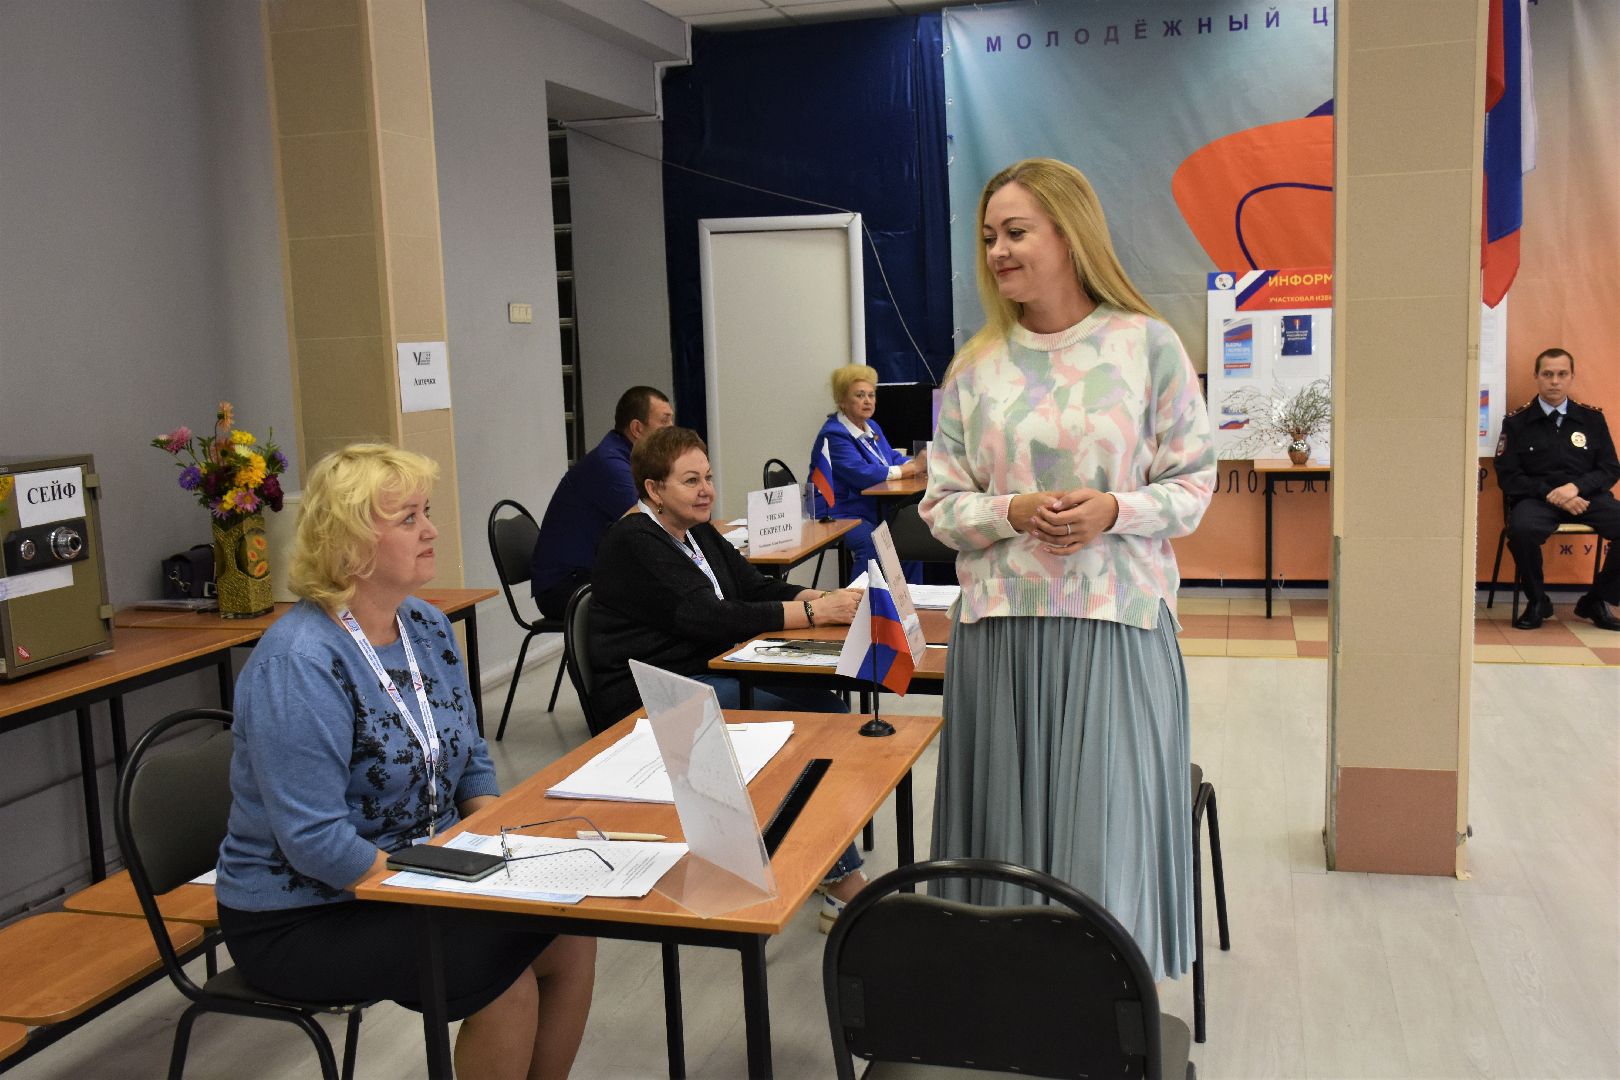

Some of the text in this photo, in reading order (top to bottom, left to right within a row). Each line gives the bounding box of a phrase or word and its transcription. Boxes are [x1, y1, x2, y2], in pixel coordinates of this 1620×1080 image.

[986, 7, 1280, 53] МОЛОДЁЖНЫЙ
[27, 479, 77, 505] СЕЙФ
[759, 523, 793, 536] СЕКРЕТАРЬ
